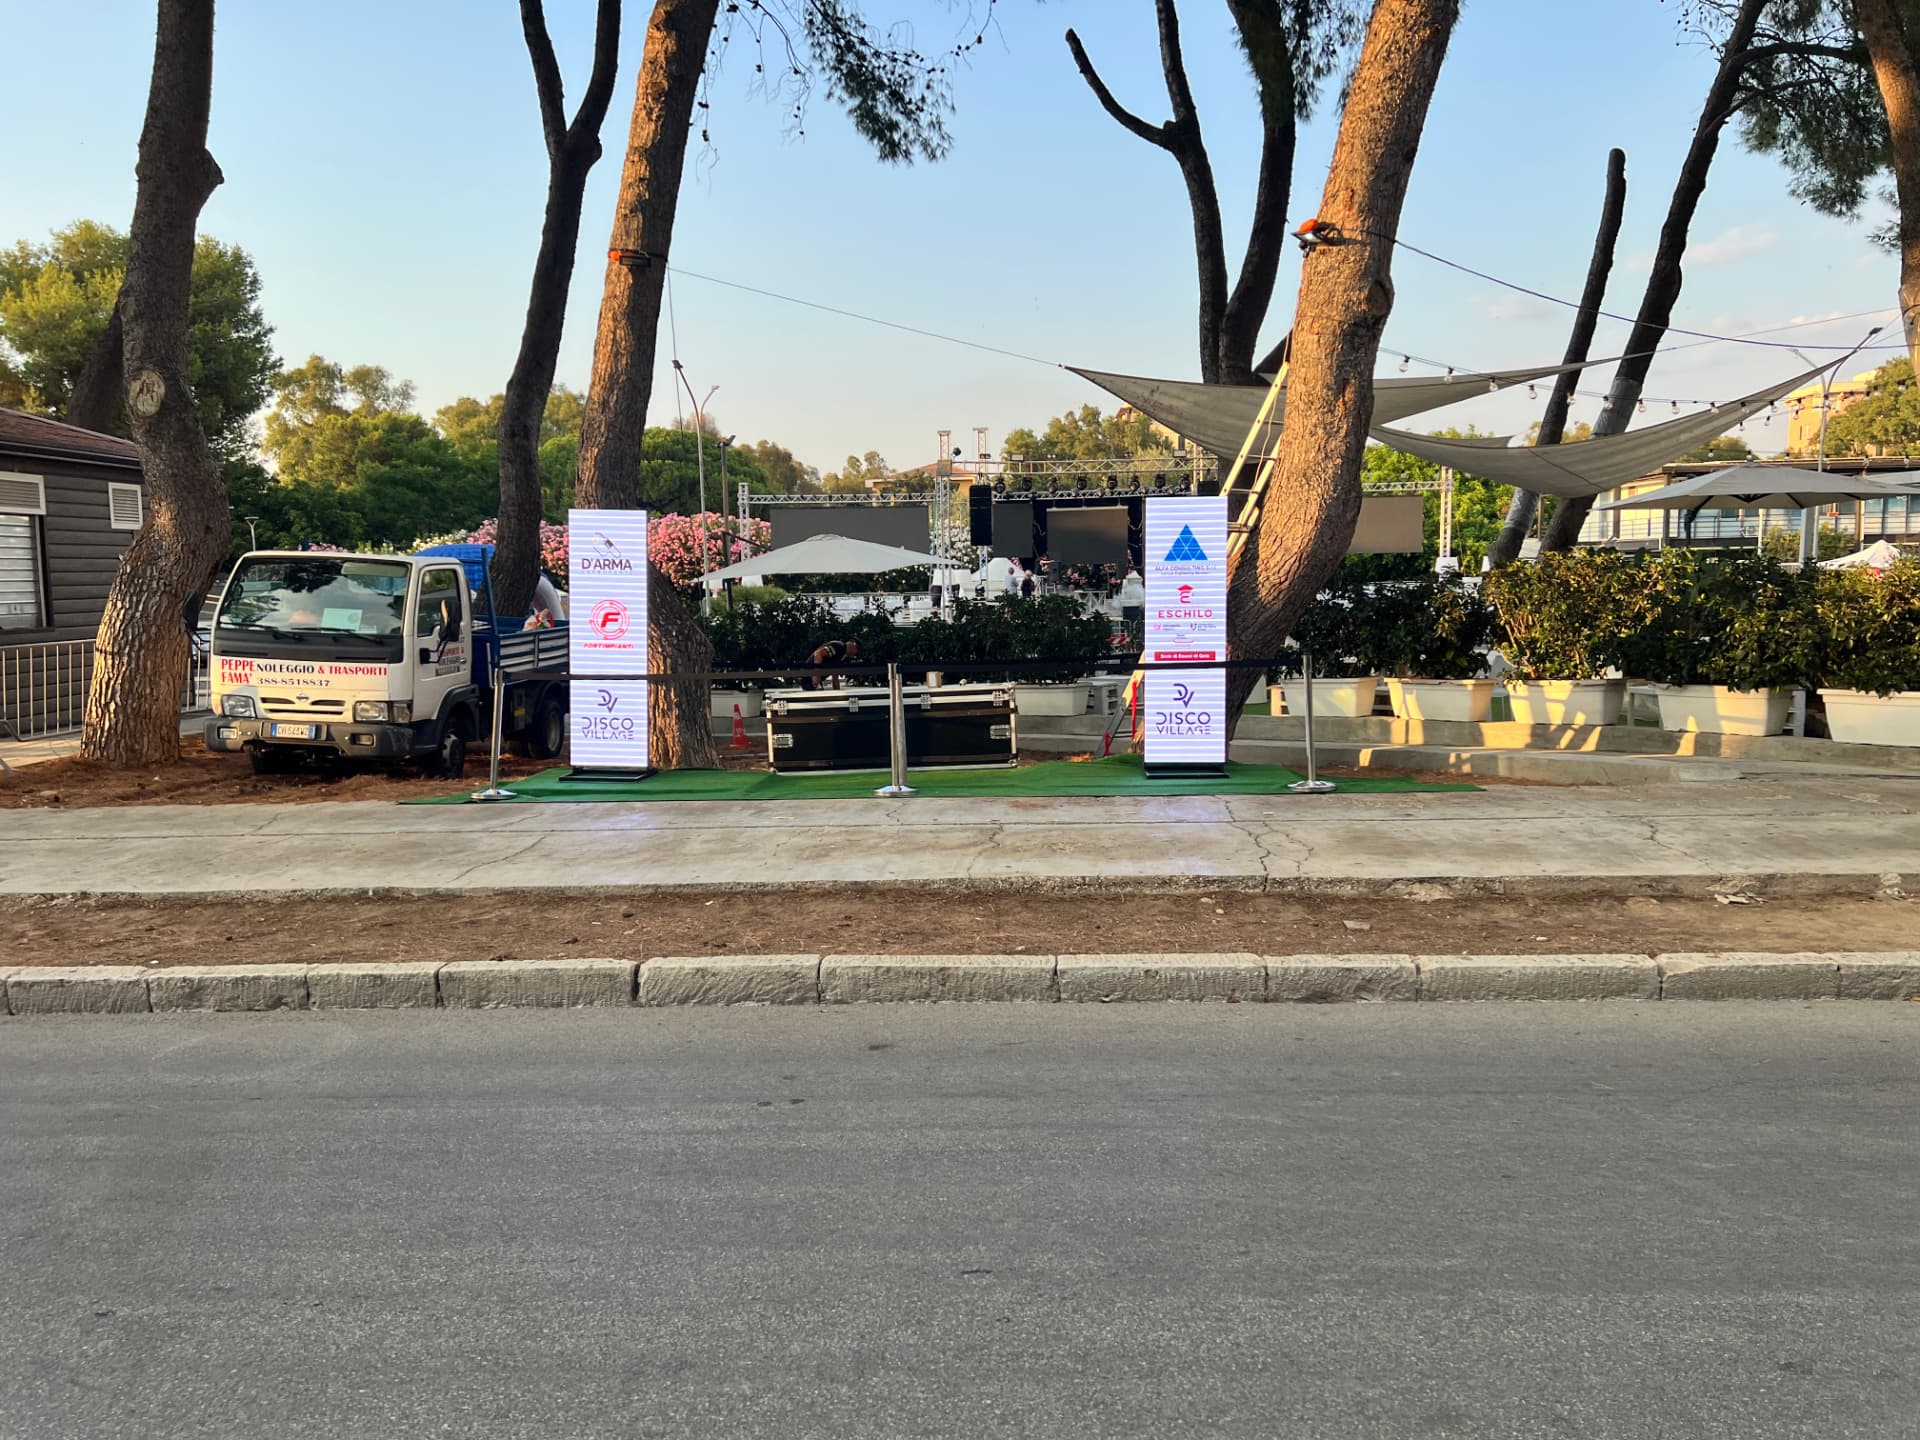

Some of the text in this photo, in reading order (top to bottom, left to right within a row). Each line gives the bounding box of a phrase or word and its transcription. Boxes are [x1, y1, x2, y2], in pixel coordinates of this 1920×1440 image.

[581, 558, 632, 570] D'ARMA
[1158, 609, 1213, 618] ESCHILO
[600, 612, 620, 628] F
[221, 658, 255, 671] PEPPE
[256, 663, 388, 676] NOLEGGIO & TRASPORTI
[257, 677, 331, 687] 388-8518837
[581, 716, 634, 730] DISCO
[1155, 711, 1211, 725] DISCO
[582, 730, 634, 740] VILLAGE
[1156, 725, 1211, 735] VILLAGE
